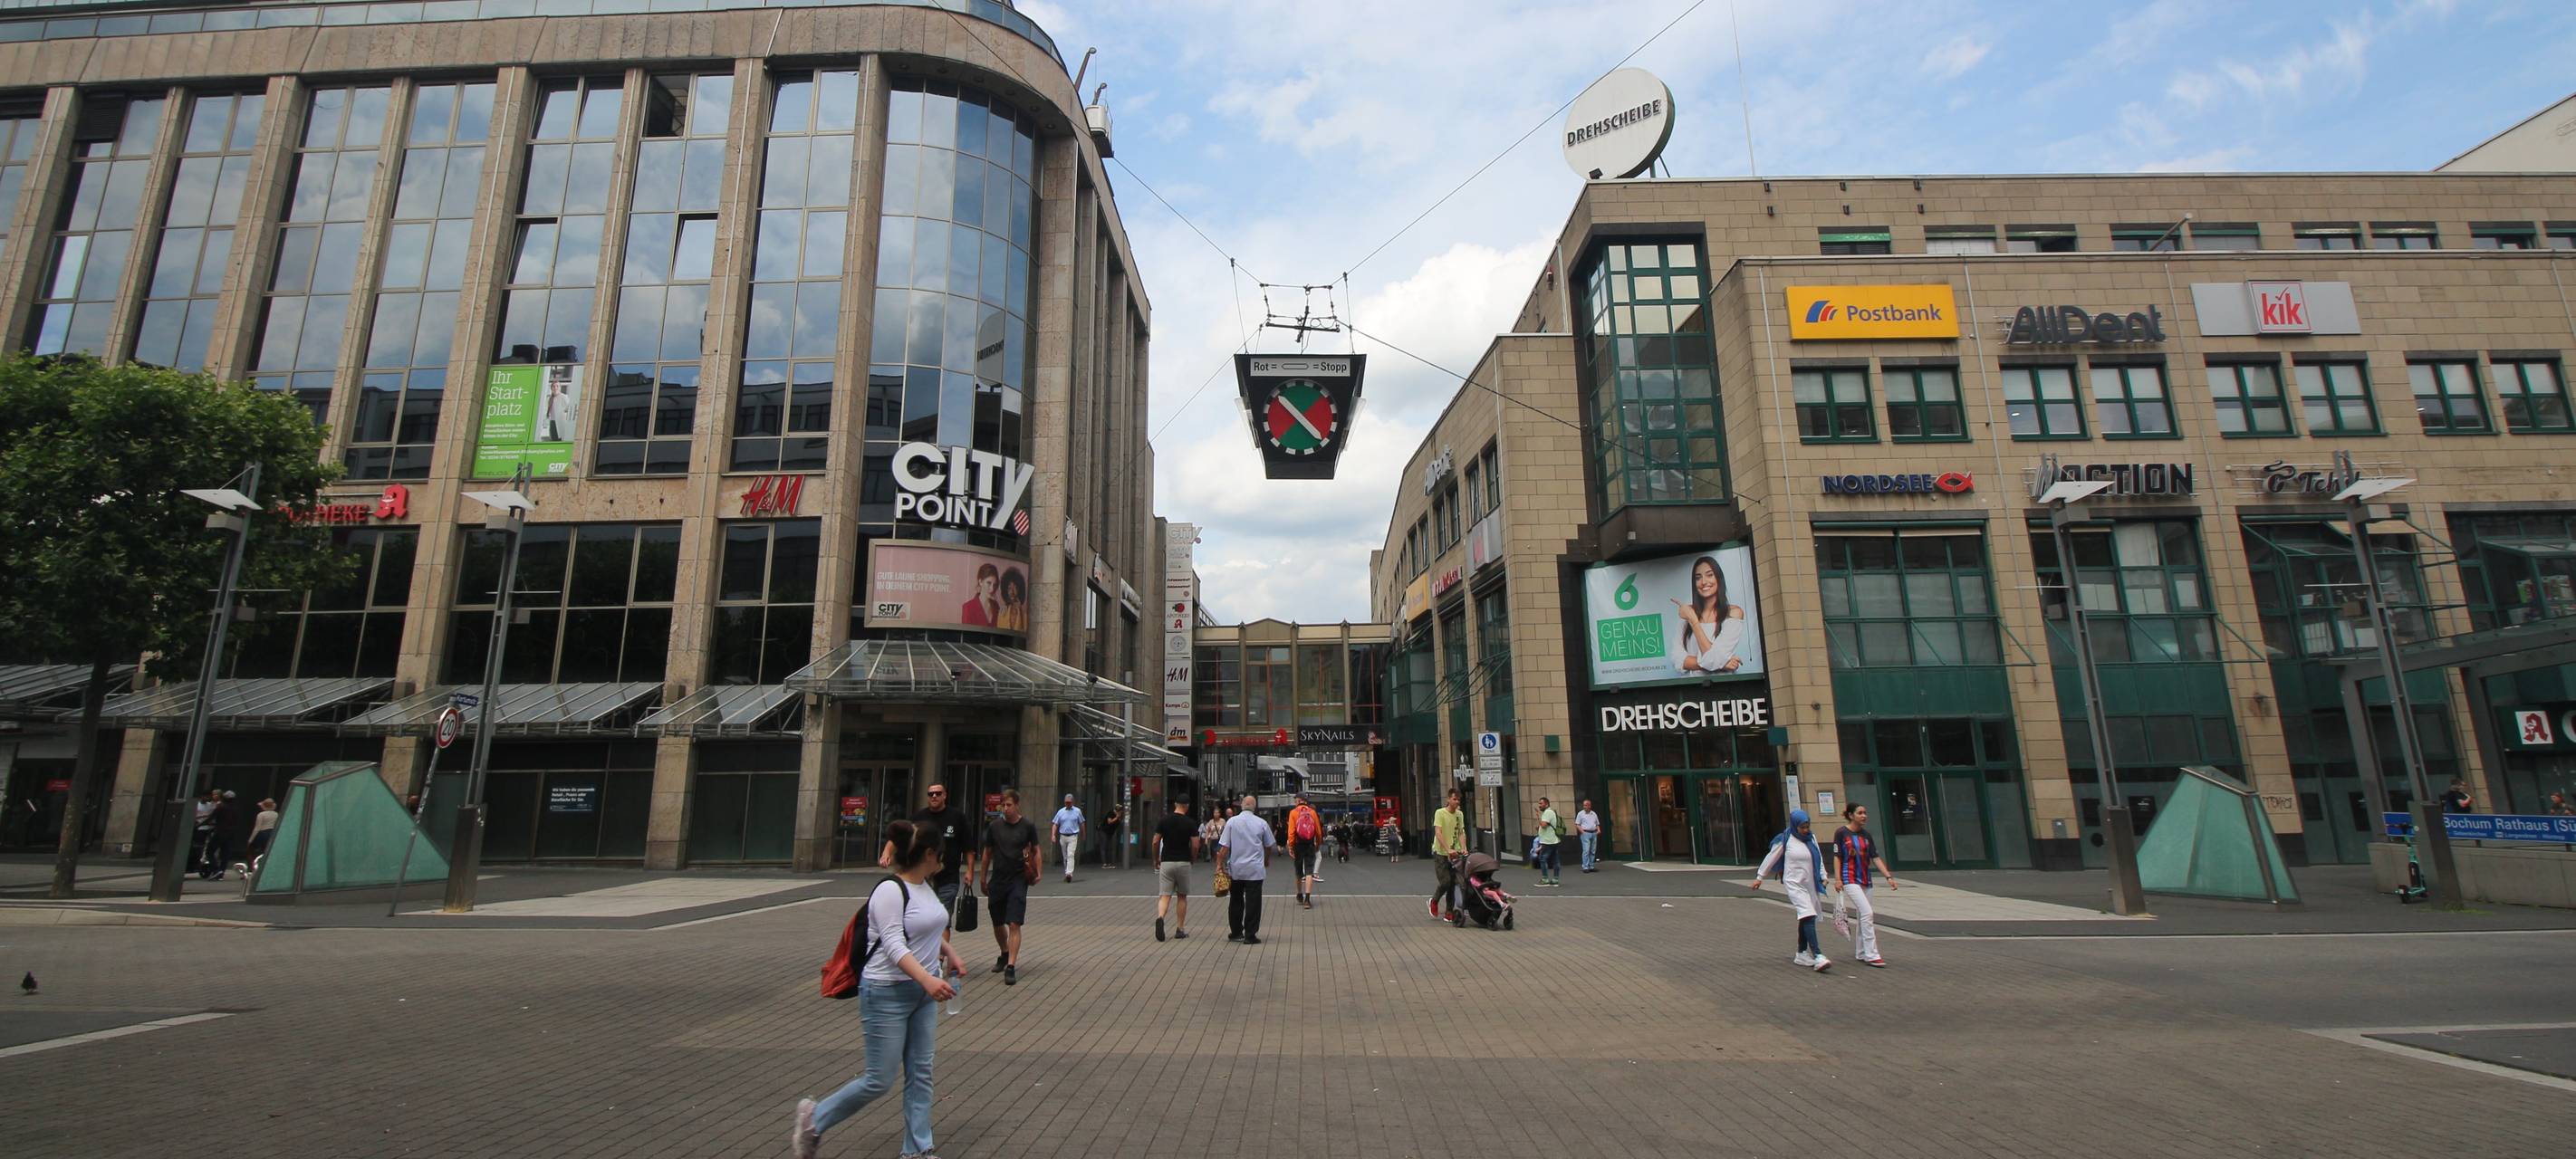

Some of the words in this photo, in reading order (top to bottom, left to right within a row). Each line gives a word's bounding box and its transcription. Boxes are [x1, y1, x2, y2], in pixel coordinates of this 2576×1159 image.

[1567, 99, 1661, 147] DREHSCHEIBE
[1847, 303, 1942, 321] Postbank
[2261, 288, 2303, 325] kik
[2007, 304, 2166, 344] AllDent
[1254, 362, 1269, 371] Rot
[1321, 362, 1347, 373] Stopp
[492, 370, 513, 385] Ihr
[489, 387, 529, 400] Start-
[486, 402, 522, 419] platz
[548, 462, 569, 473] CITY
[892, 442, 1035, 531] CITY
[1821, 474, 1934, 494] NORDSEE
[740, 474, 805, 516] H&M
[895, 493, 993, 528] POINT
[913, 582, 928, 591] CITY
[879, 604, 903, 616] CITY
[1600, 618, 1659, 639] GENAU
[1601, 637, 1661, 658] MEINS!
[1600, 698, 1768, 732] DREHSCHEIBE
[441, 719, 455, 736] 20
[1170, 726, 1186, 737] dm
[2443, 817, 2492, 829] Bochum
[2494, 818, 2550, 831] Rathaus
